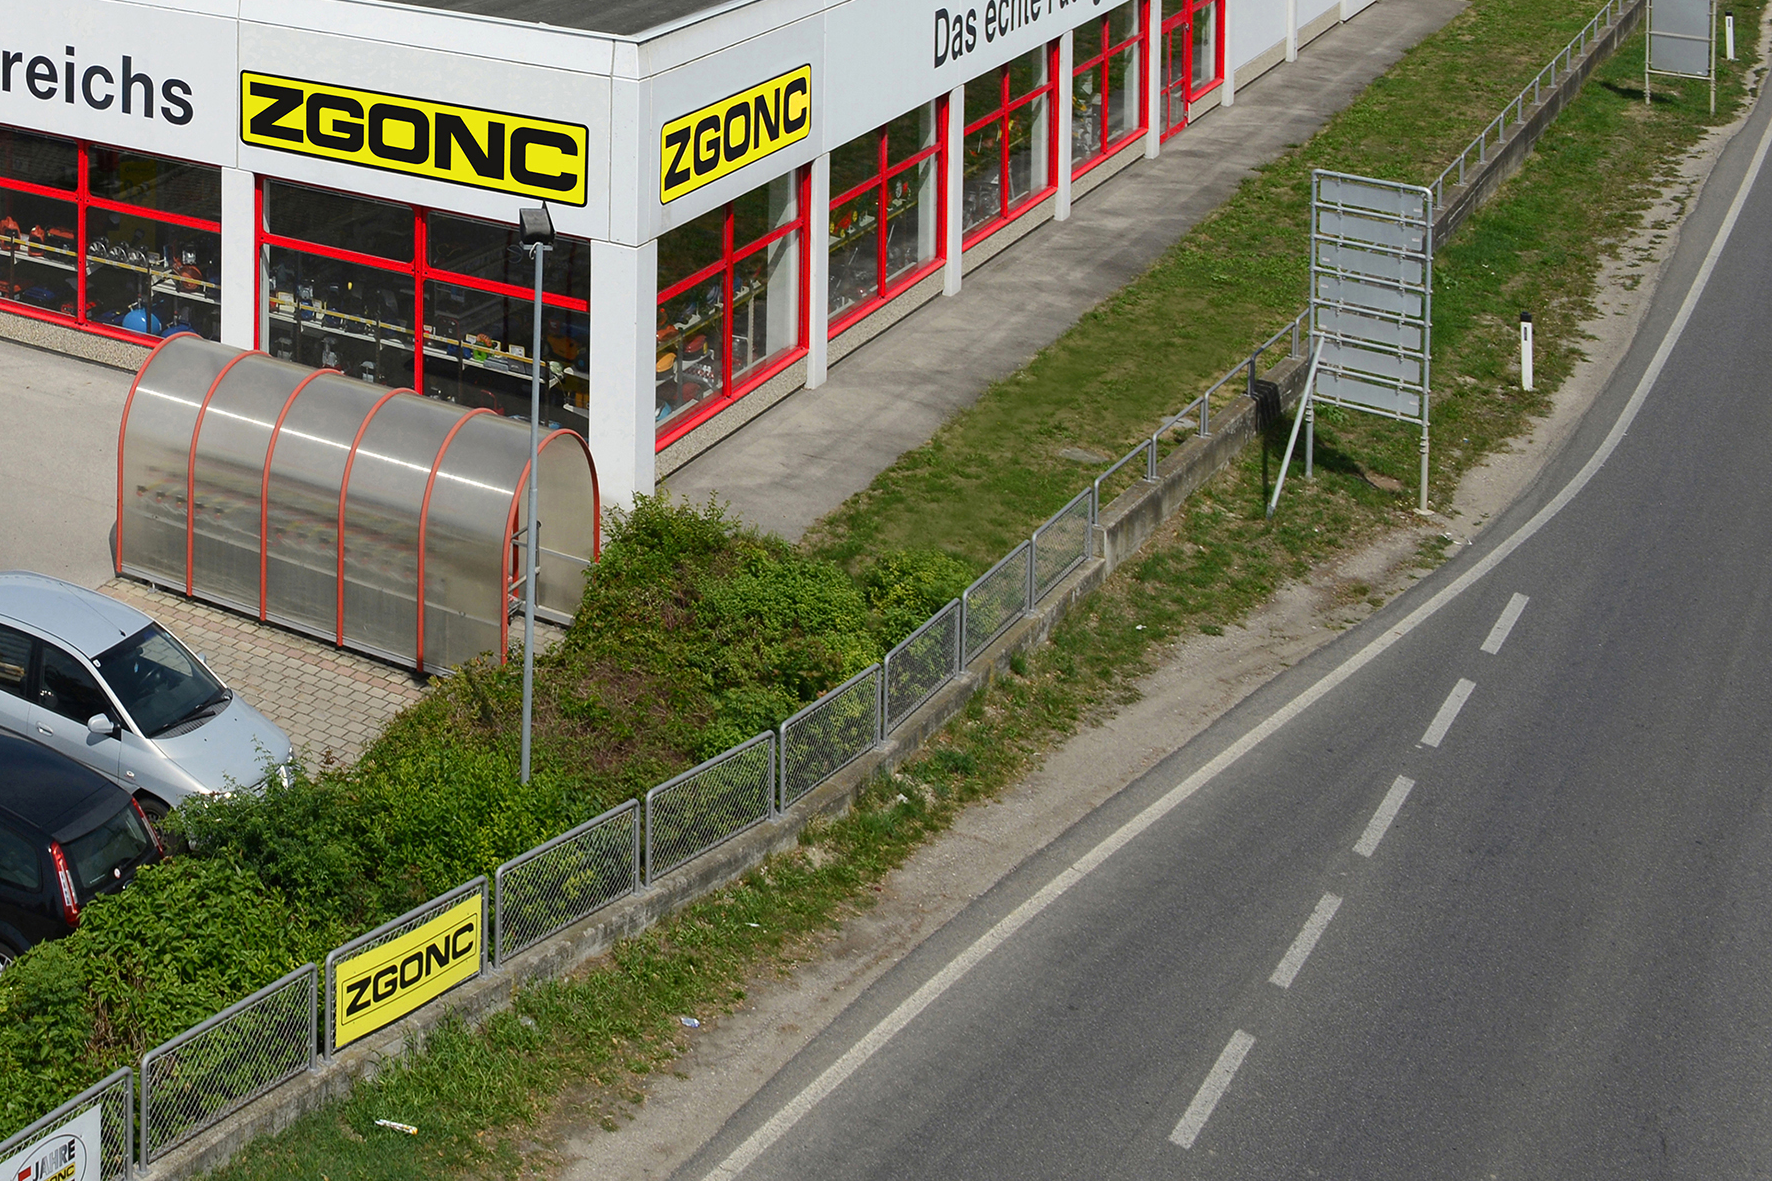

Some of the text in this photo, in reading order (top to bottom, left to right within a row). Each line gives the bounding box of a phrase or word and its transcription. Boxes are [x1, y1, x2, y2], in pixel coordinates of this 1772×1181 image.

[934, 8, 977, 69] Das
[249, 81, 578, 192] ZGONC
[664, 76, 808, 192] ZGONC
[346, 922, 474, 1017] ZGONC
[32, 1138, 76, 1181] JAHRE
